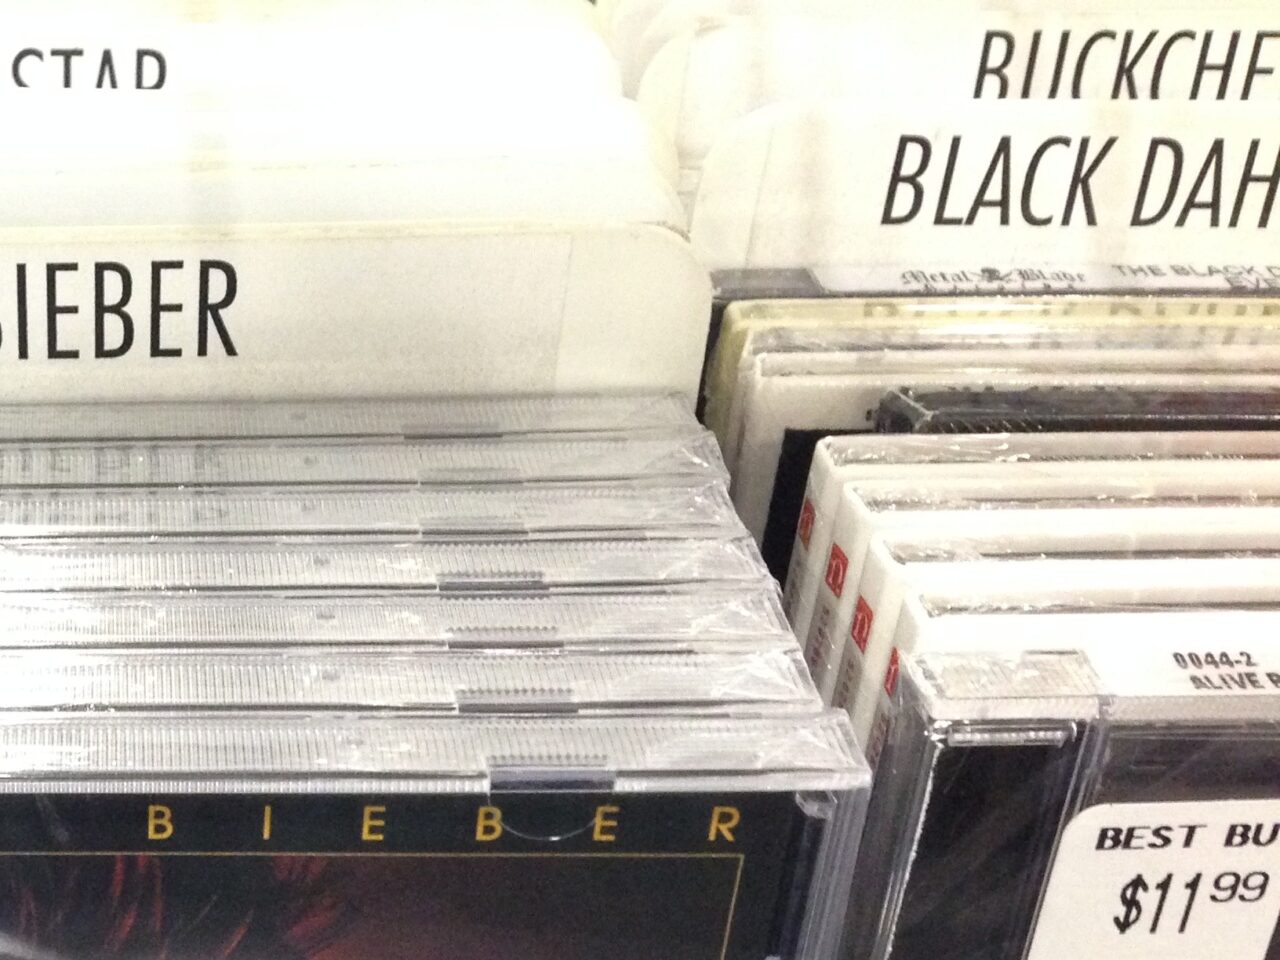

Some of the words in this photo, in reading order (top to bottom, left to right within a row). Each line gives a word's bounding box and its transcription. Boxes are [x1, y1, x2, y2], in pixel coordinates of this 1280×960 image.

[880, 134, 1119, 227] BLACK
[1130, 137, 1280, 229] DAH
[147, 805, 741, 842] BIEBER
[1095, 824, 1208, 851] BEST
